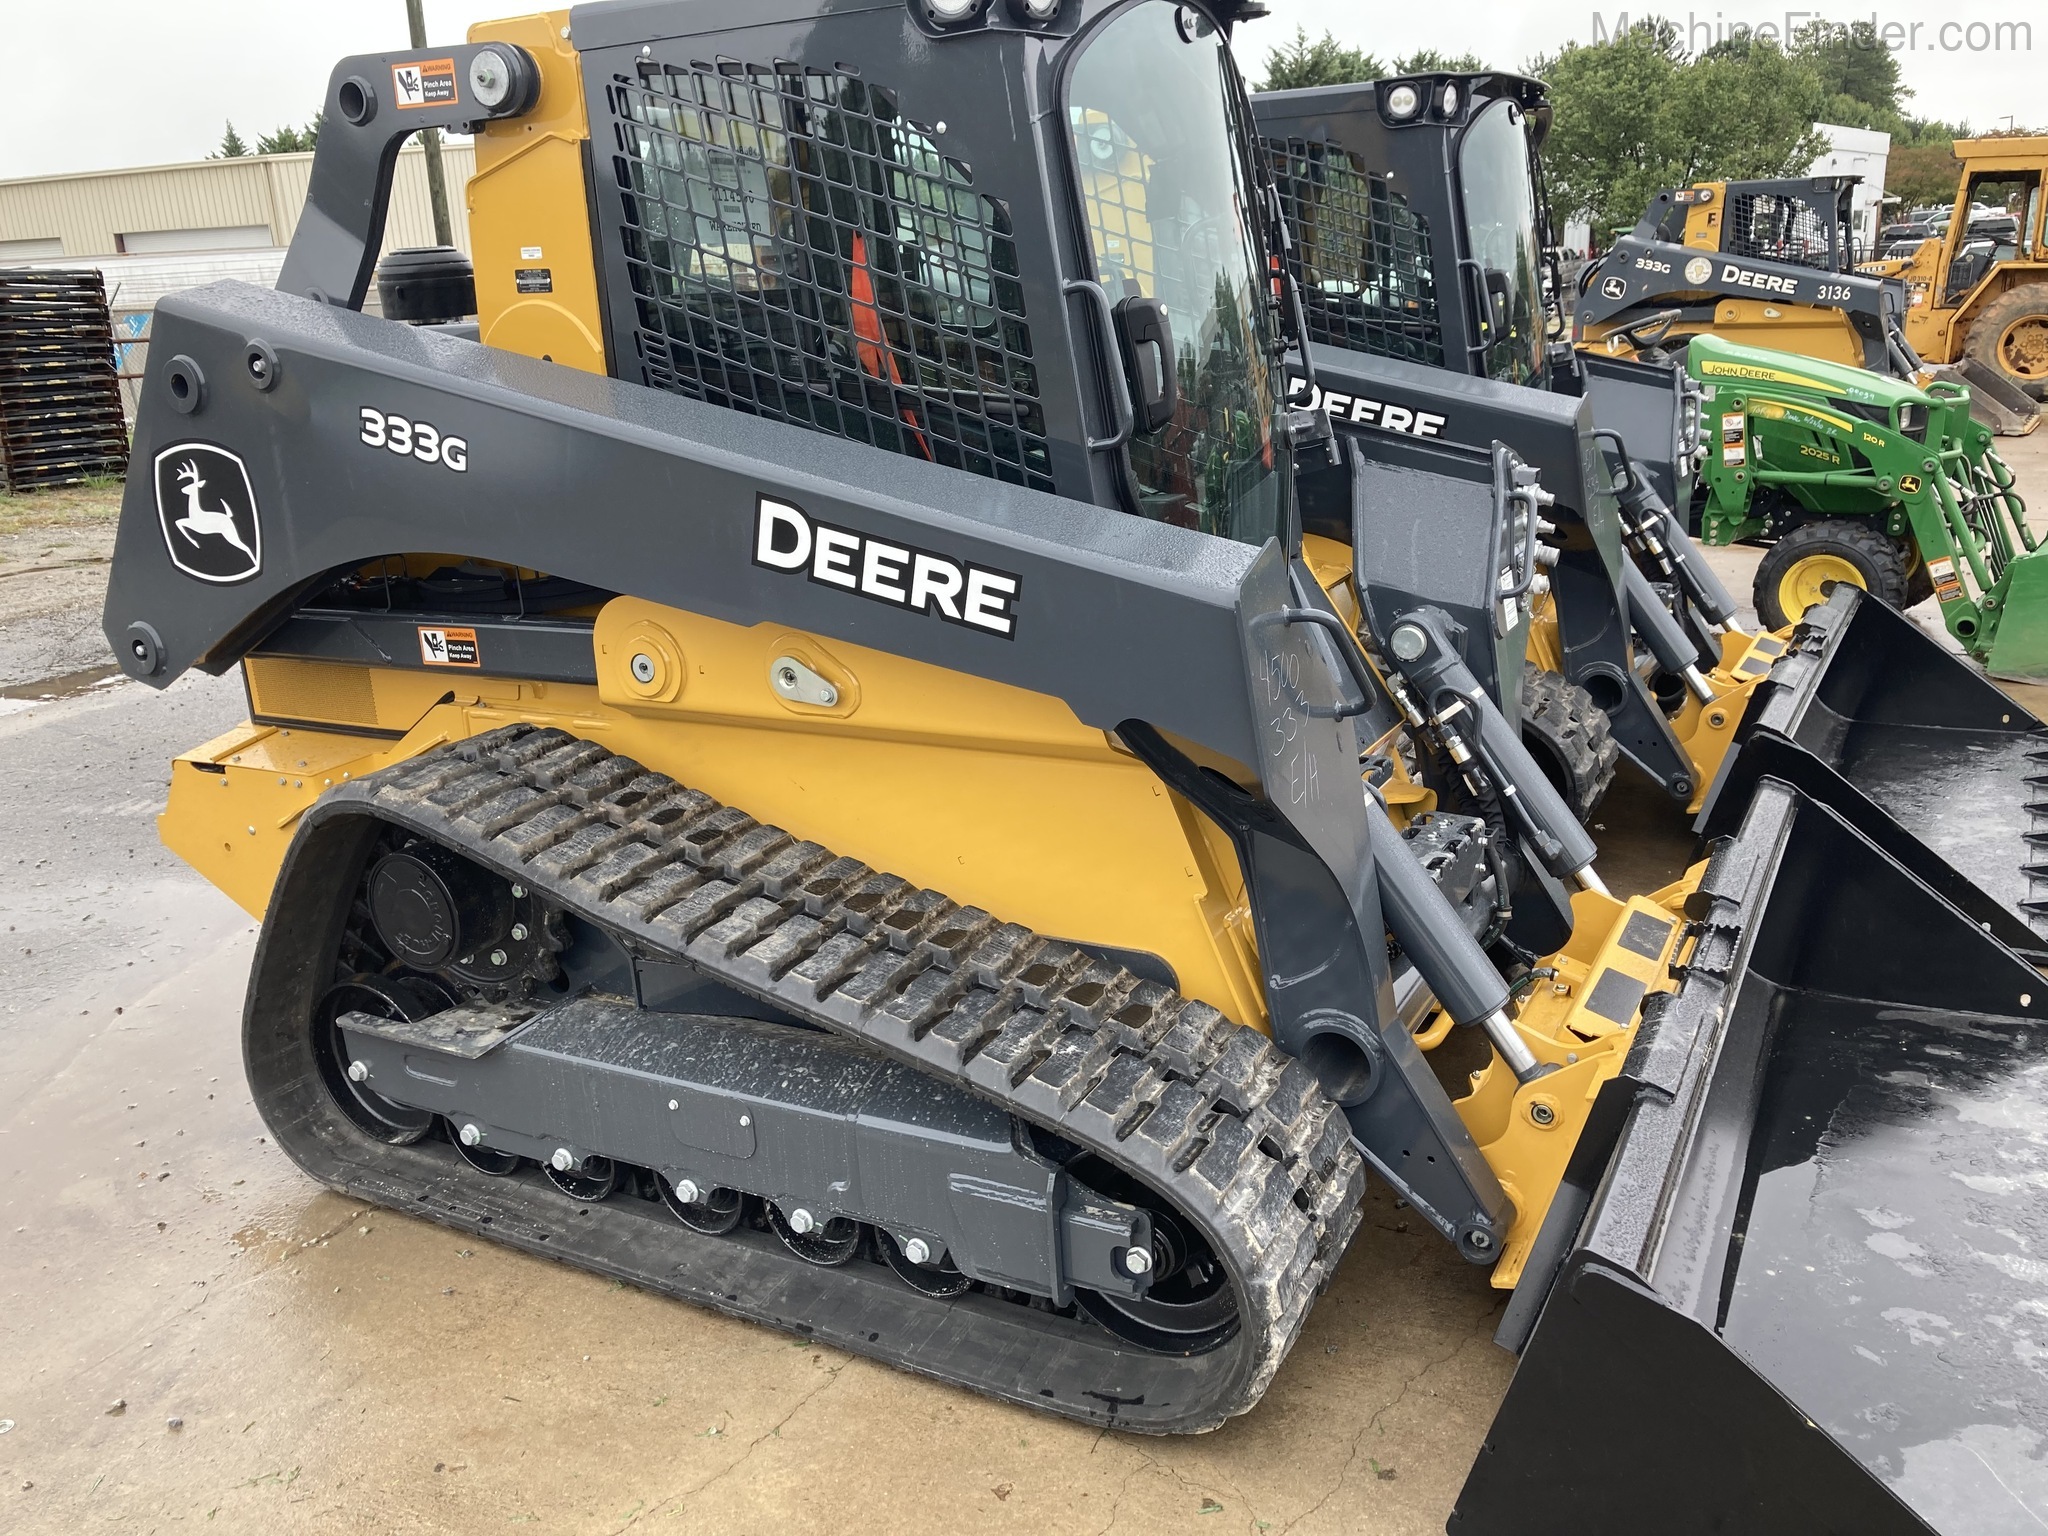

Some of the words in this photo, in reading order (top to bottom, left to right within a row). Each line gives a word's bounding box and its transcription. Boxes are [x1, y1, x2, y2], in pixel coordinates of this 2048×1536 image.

[423, 80, 439, 89] Pinch
[439, 79, 452, 87] Area
[425, 90, 437, 98] Keep
[437, 89, 449, 97] Away
[1635, 257, 1671, 274] 333G
[1720, 263, 1798, 295] DEERE
[1817, 284, 1851, 300] 3136
[1709, 364, 1738, 375] JOHN
[1738, 366, 1776, 380] DEERE
[361, 408, 467, 472] 333G
[1863, 432, 1877, 444] 120
[1800, 445, 1830, 461] 2025
[1831, 455, 1840, 465] R
[757, 498, 1016, 634] DEERE
[449, 652, 460, 660] Keep
[1259, 650, 1300, 707] 4500
[1270, 690, 1310, 757] 333
[1290, 735, 1320, 809] E/H
